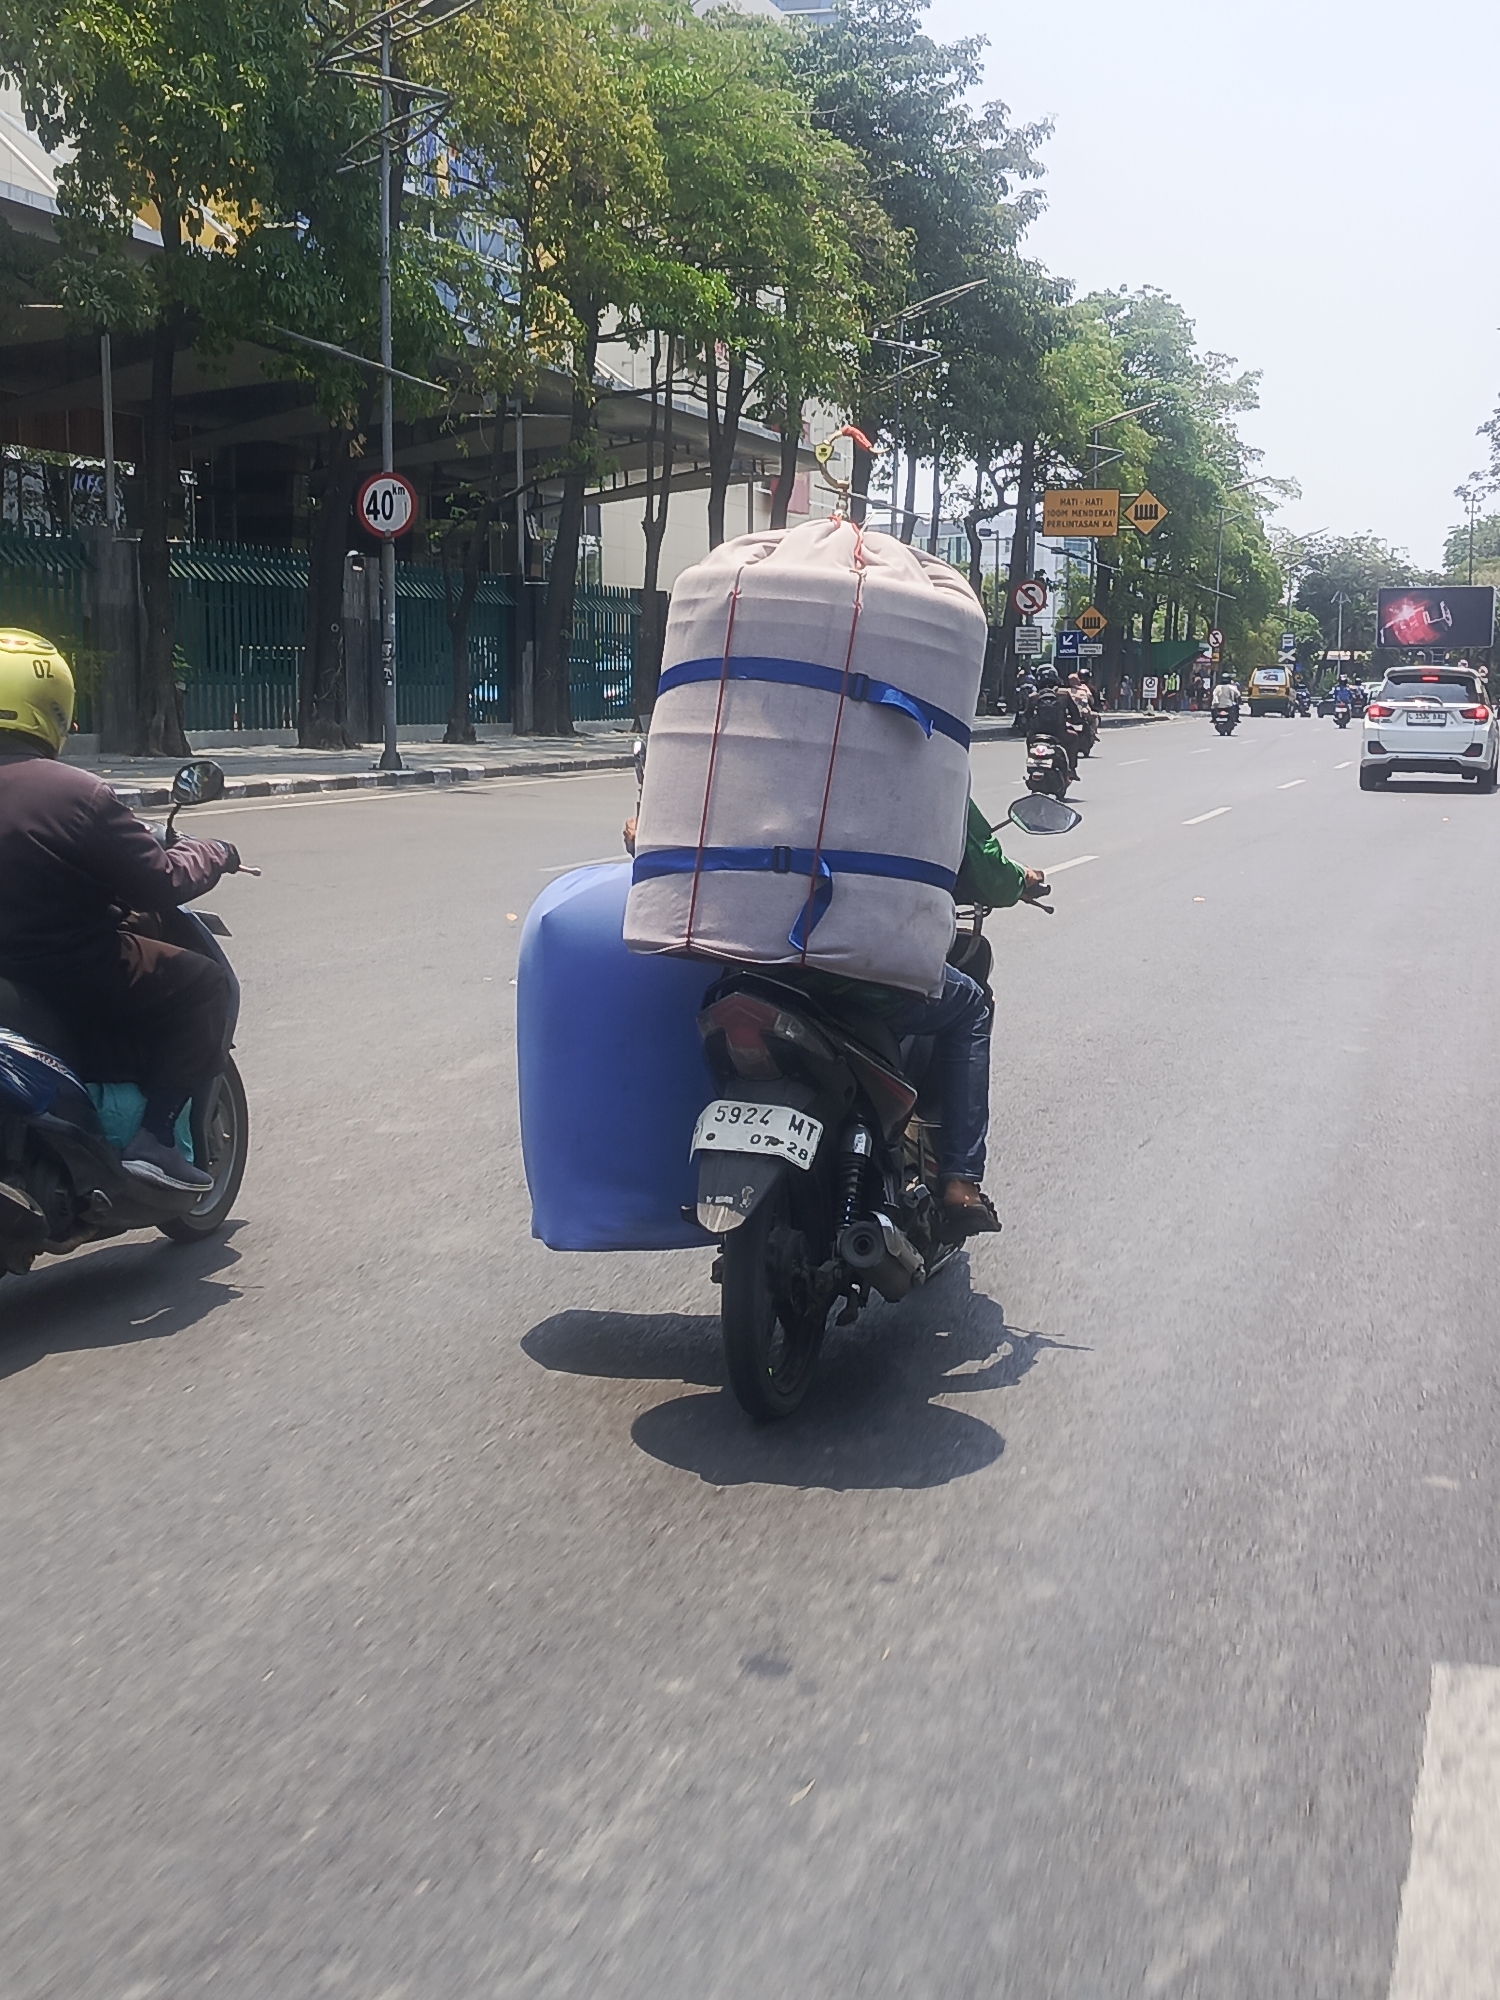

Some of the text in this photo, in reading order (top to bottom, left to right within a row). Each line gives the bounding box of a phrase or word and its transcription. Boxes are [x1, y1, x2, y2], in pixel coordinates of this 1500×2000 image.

[365, 483, 406, 521] 40 km
[1060, 498, 1078, 506] HATI
[1085, 498, 1103, 506] HATI
[1047, 509, 1116, 518] 100M MENDEKATI
[1046, 520, 1114, 529] PERLINTASAN KA
[715, 1105, 818, 1141] 5924 MT
